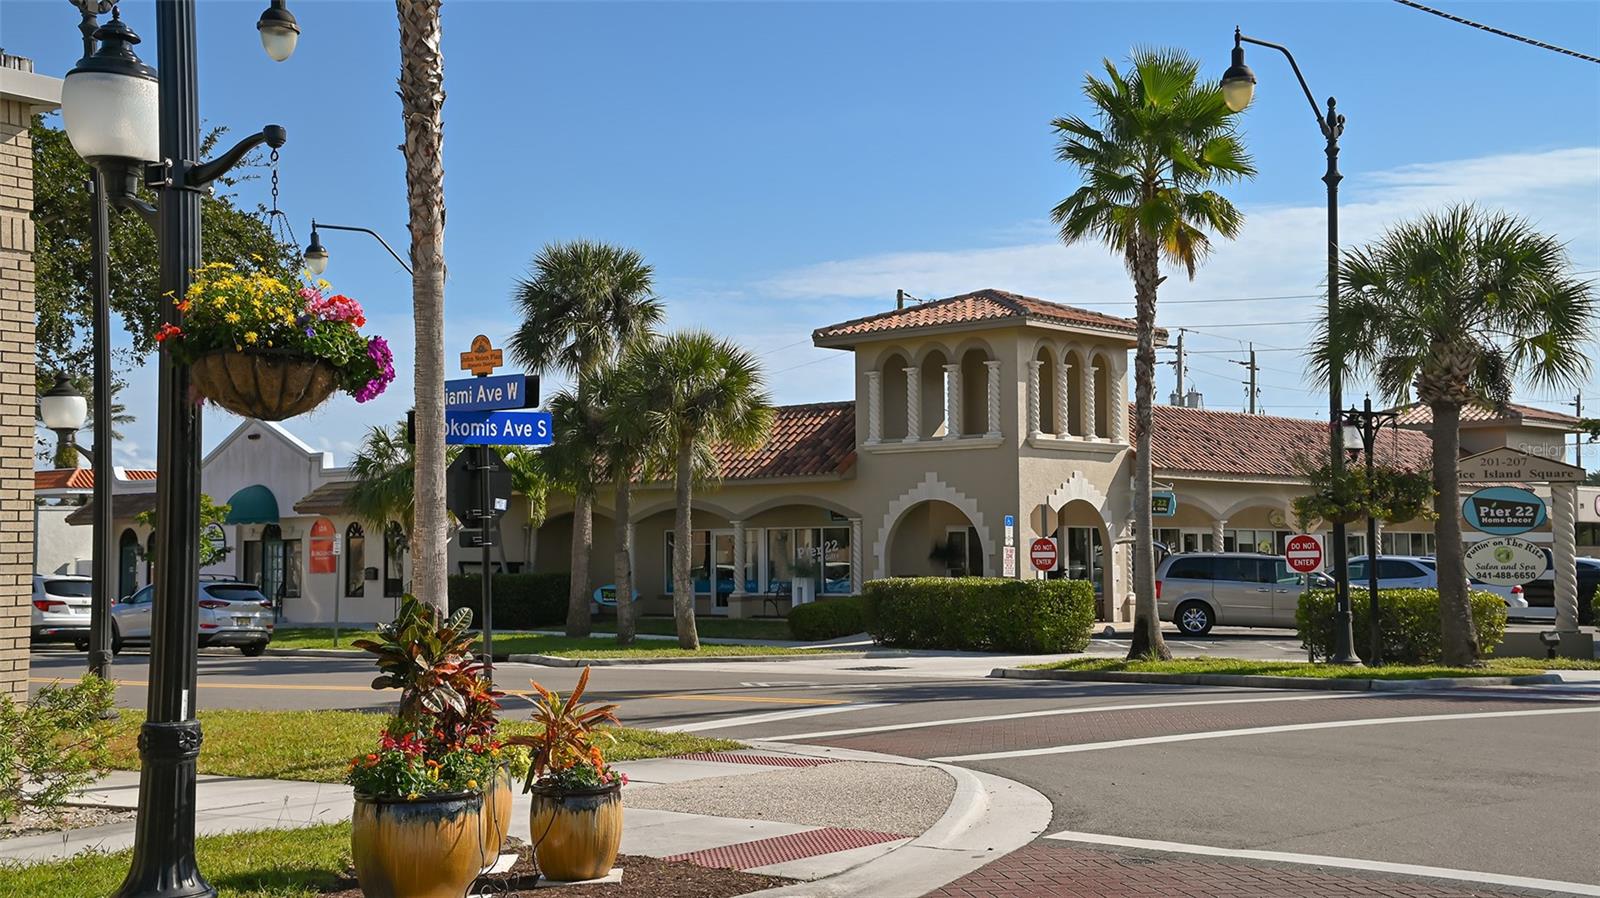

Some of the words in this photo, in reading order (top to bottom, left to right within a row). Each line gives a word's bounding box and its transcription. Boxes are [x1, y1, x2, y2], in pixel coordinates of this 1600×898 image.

[444, 386, 472, 405] iami
[476, 385, 503, 403] Ave
[507, 382, 518, 401] W
[444, 418, 498, 437] okomis
[503, 419, 533, 437] Ave
[537, 419, 547, 438] S
[1480, 457, 1527, 467] 201-207
[1457, 470, 1476, 479] ice
[1484, 469, 1521, 479] Island
[1529, 469, 1574, 480] Square
[1480, 504, 1512, 517] Pier
[1515, 506, 1534, 517] 22
[824, 540, 839, 554] 22
[1290, 542, 1301, 550] DO
[1302, 542, 1316, 550] NOT
[1505, 538, 1523, 548] The
[1524, 543, 1544, 560] Ritz
[1293, 559, 1315, 567] ENTER
[1475, 563, 1498, 571] Salon
[1500, 563, 1517, 571] and
[1519, 562, 1536, 571] Spa
[1476, 571, 1536, 580] 941-488-6650
